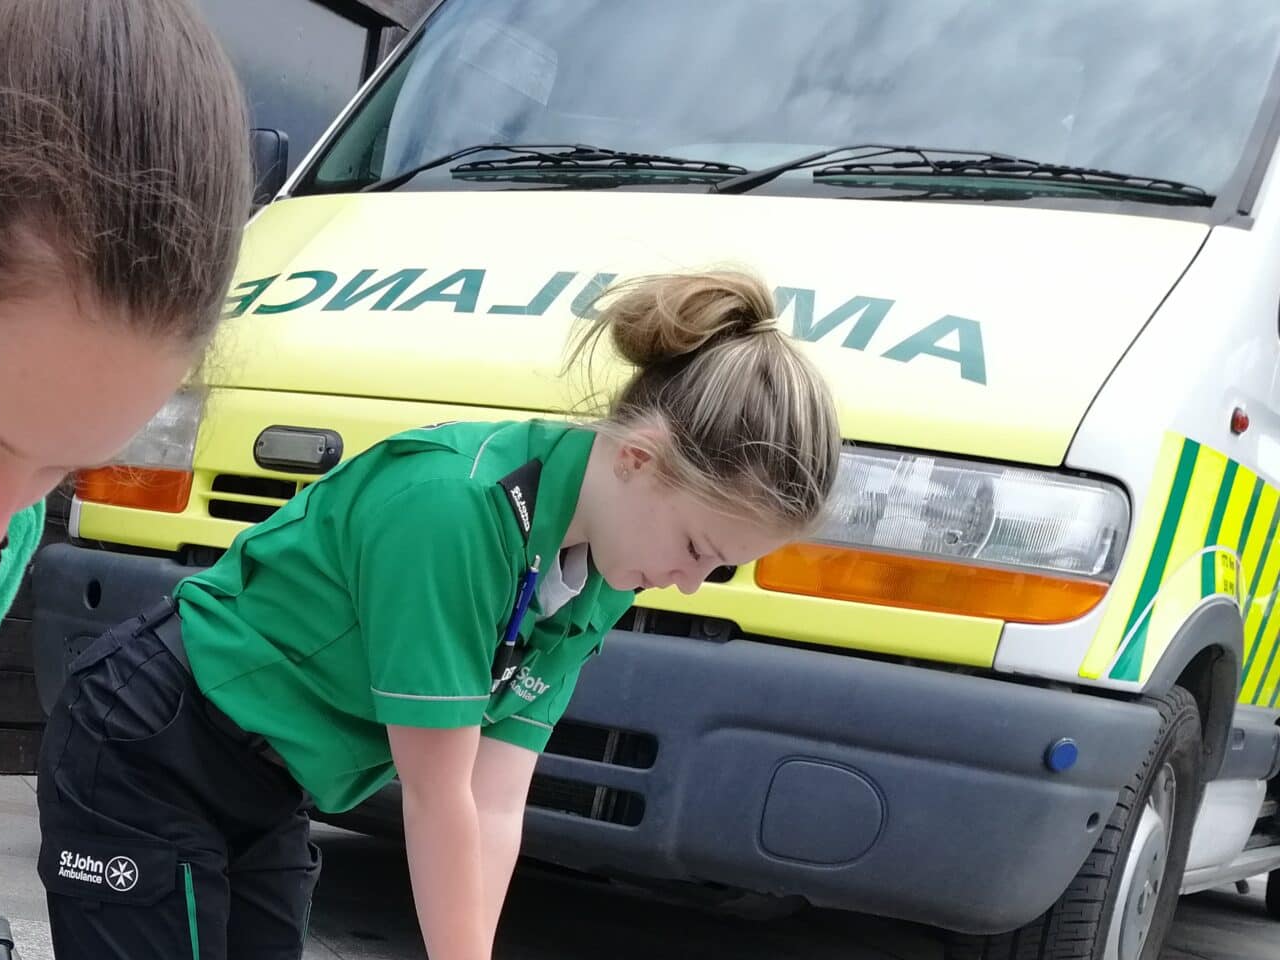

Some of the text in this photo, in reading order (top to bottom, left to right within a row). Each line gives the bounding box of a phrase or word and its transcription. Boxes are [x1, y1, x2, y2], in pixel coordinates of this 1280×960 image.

[60, 850, 103, 873] St John
[58, 866, 103, 884] Ambulance
